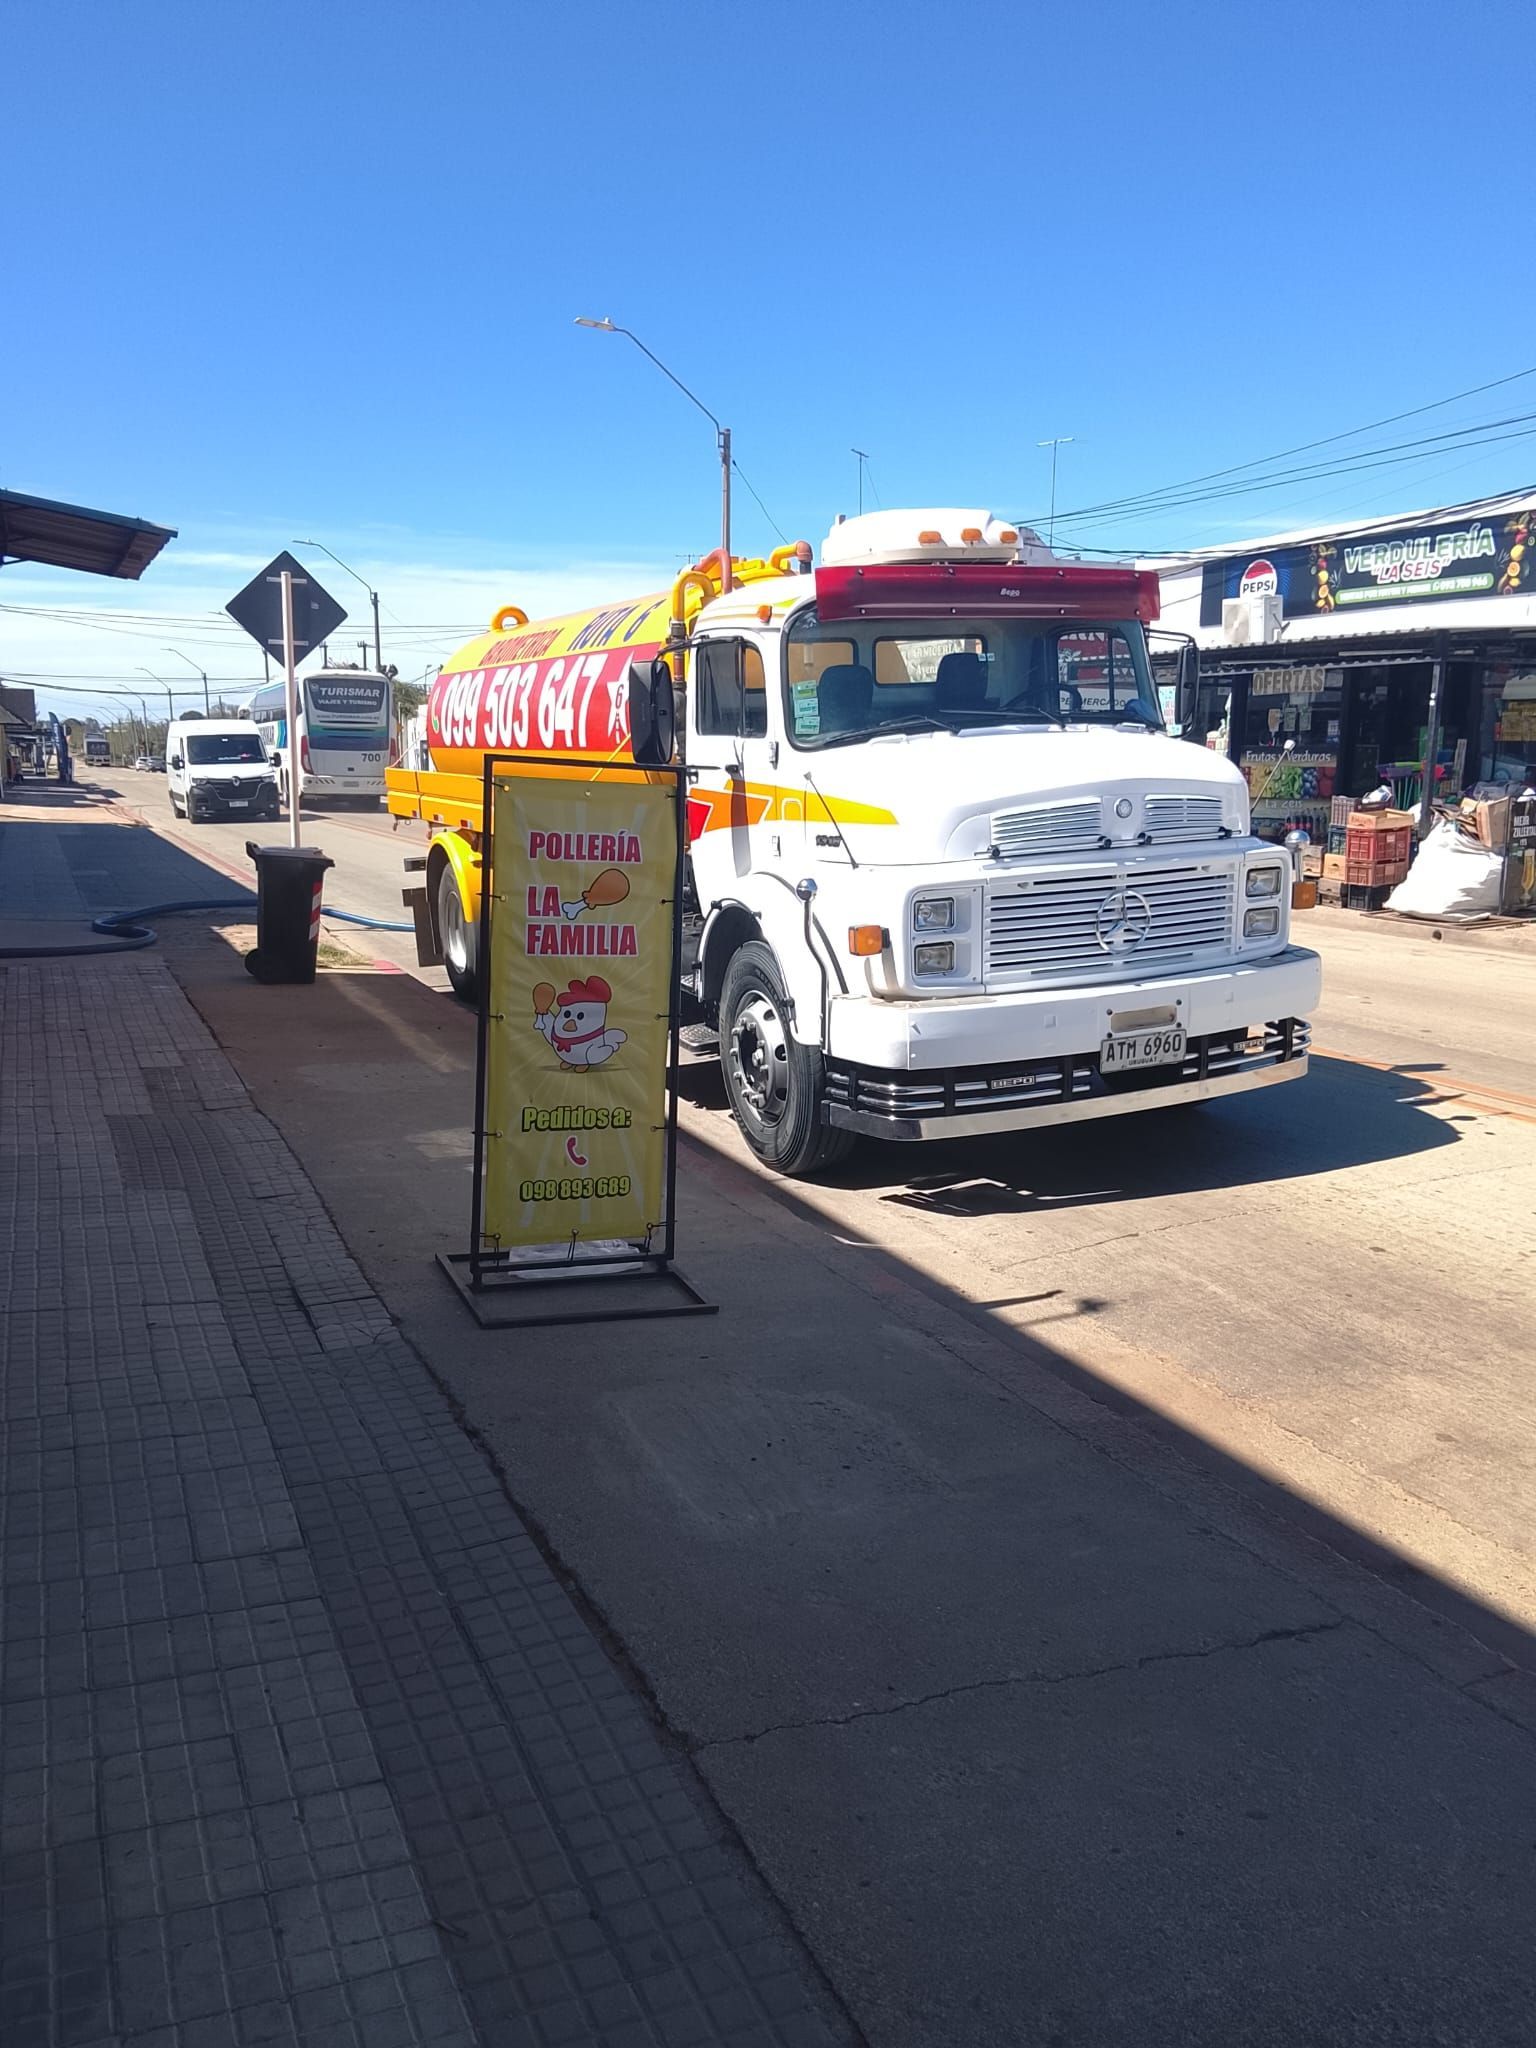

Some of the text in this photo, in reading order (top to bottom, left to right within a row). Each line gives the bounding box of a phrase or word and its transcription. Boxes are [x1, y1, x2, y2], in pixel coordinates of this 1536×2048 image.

[1344, 523, 1496, 573] VERDULERÍA
[1243, 581, 1274, 593] PEPSI
[623, 599, 667, 643] 6
[320, 687, 380, 698] TURISMAR
[1253, 669, 1323, 695] OFERTAS
[441, 654, 608, 749] 099 503 647
[361, 753, 380, 762] 700
[1246, 750, 1274, 762] Frutas
[1287, 750, 1331, 762] Verduras
[529, 830, 642, 863] POLLERÍA
[527, 885, 561, 917] LA
[526, 923, 638, 956] FAMILIA
[1106, 1033, 1182, 1063] ATM 6960
[1128, 1057, 1158, 1066] URUGUAY
[522, 1106, 632, 1132] Pedidos a:
[520, 1176, 631, 1202] 098 893 689
